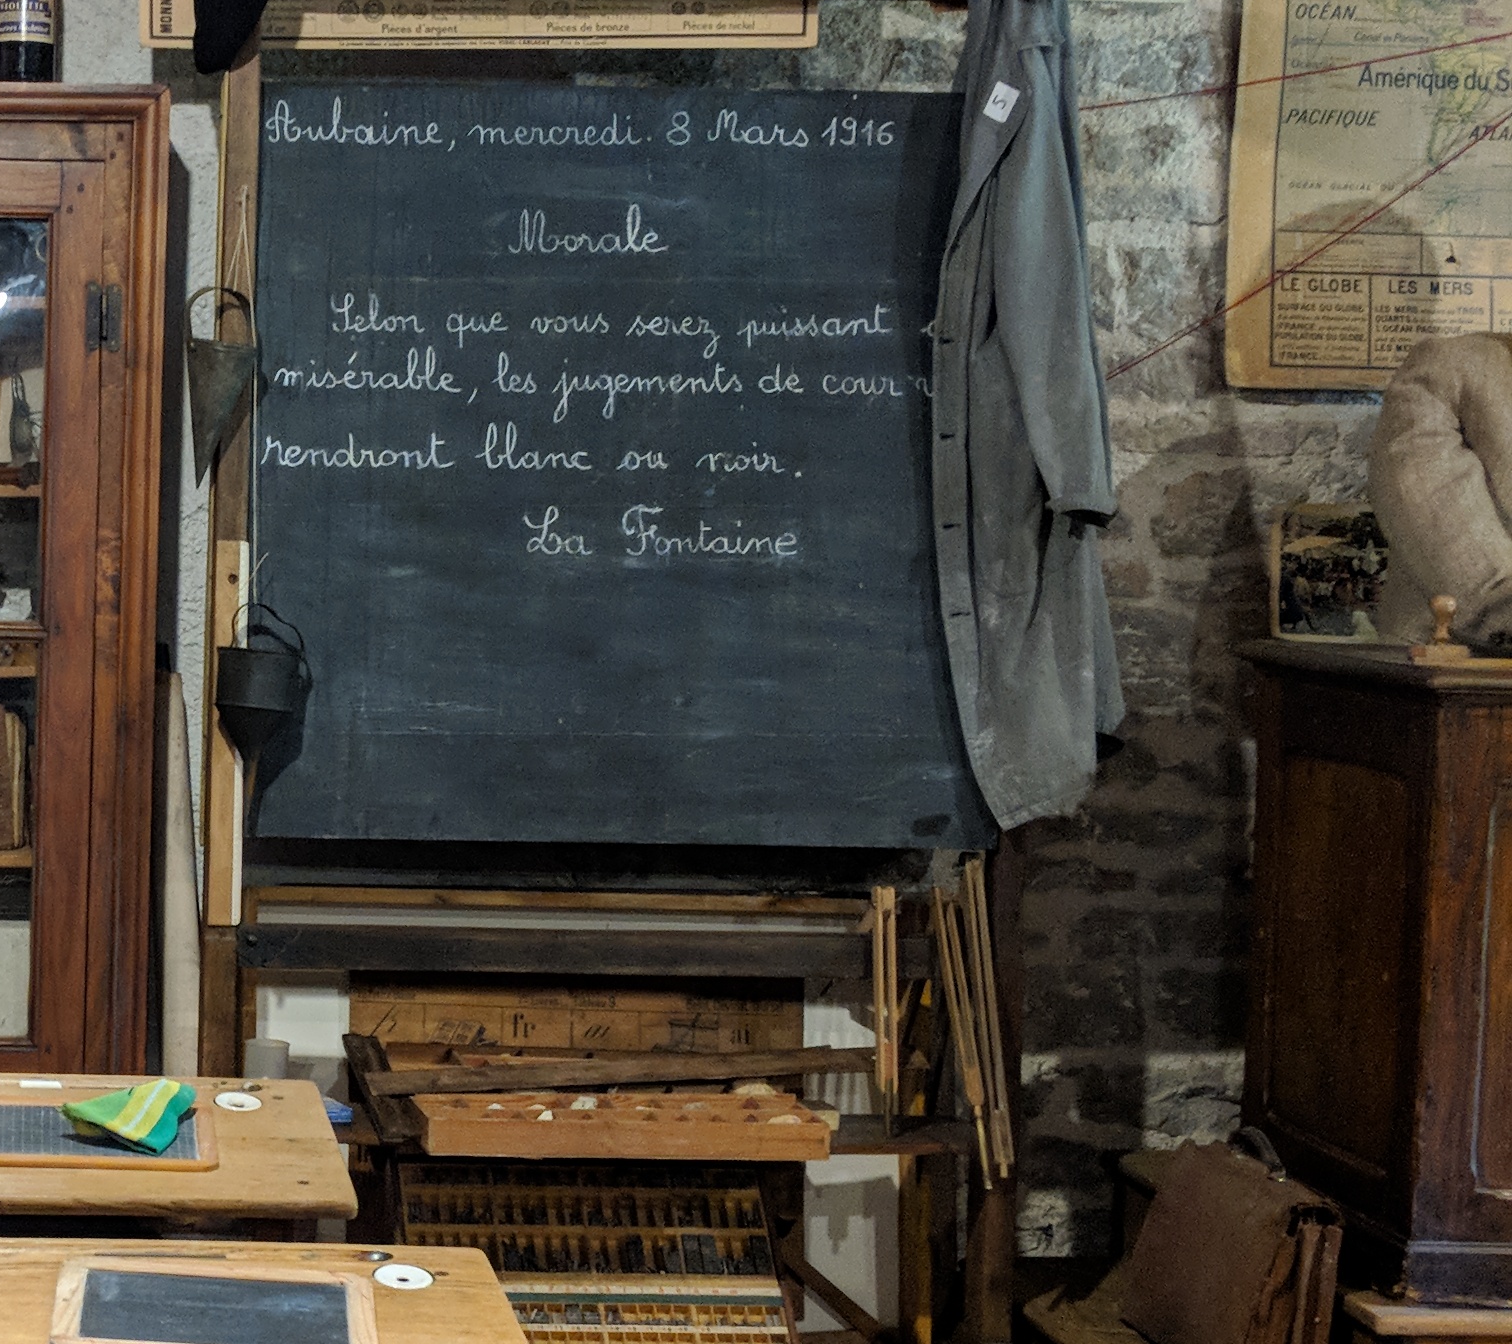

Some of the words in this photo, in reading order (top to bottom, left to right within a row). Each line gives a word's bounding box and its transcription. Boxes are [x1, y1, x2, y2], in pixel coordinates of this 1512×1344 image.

[1295, 3, 1357, 20] OCÉAN
[382, 24, 412, 34] Pièces
[416, 23, 458, 36] d'argent
[546, 22, 577, 32] Pièces
[581, 22, 593, 32] de
[596, 22, 630, 32] bronze
[683, 20, 713, 31] Pièces
[716, 21, 727, 31] de
[729, 20, 756, 31] nickel
[1358, 62, 1459, 95] Amérique
[1464, 71, 1488, 91] du
[265, 96, 456, 152] Aubaine,
[467, 110, 642, 147] mercredi
[666, 111, 691, 146] 8
[707, 108, 810, 147] Mars
[821, 114, 895, 147] 1916
[1285, 109, 1380, 128] PACIFIQUE
[508, 203, 670, 254] Morale
[1280, 278, 1300, 292] LE
[1308, 278, 1363, 293] GLOBE
[1388, 280, 1417, 294] LES
[1430, 281, 1474, 295] MERS
[331, 293, 425, 335] Selon
[445, 311, 508, 351] que
[531, 311, 610, 335] vous
[625, 311, 721, 359] serez
[737, 307, 891, 348] puissant
[274, 351, 479, 405] misérable,
[492, 352, 538, 395] les
[550, 361, 745, 422] jugements
[758, 364, 804, 395] de
[822, 373, 897, 396] cour
[260, 431, 457, 469] rendront
[477, 422, 593, 470] blanc
[616, 450, 670, 470] ou
[524, 506, 593, 555] La
[621, 505, 799, 555] Fontaine
